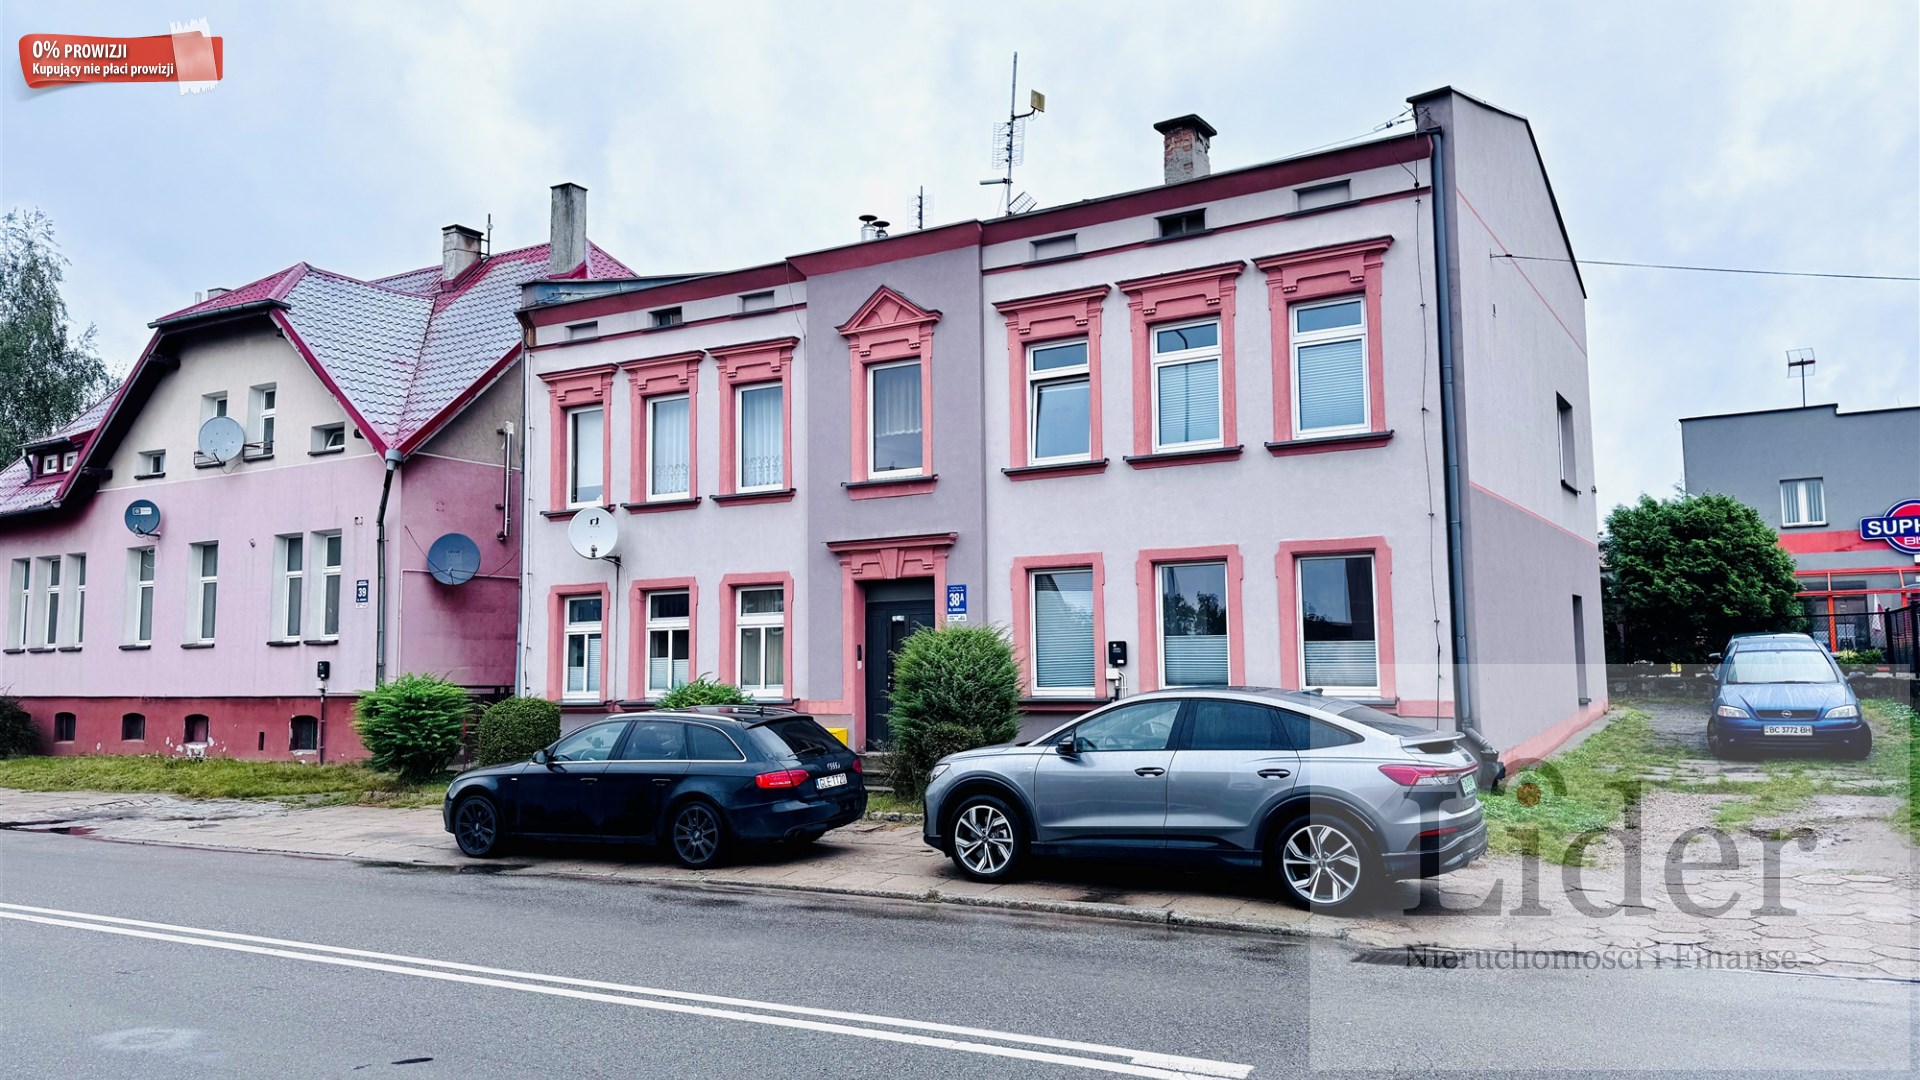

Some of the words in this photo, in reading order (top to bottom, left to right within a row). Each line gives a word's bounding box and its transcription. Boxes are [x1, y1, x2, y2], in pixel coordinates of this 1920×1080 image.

[1903, 536, 1920, 546] BI
[357, 587, 367, 597] 39
[1769, 726, 1780, 734] BC
[1781, 726, 1798, 734] 3772
[1800, 726, 1812, 734] BH
